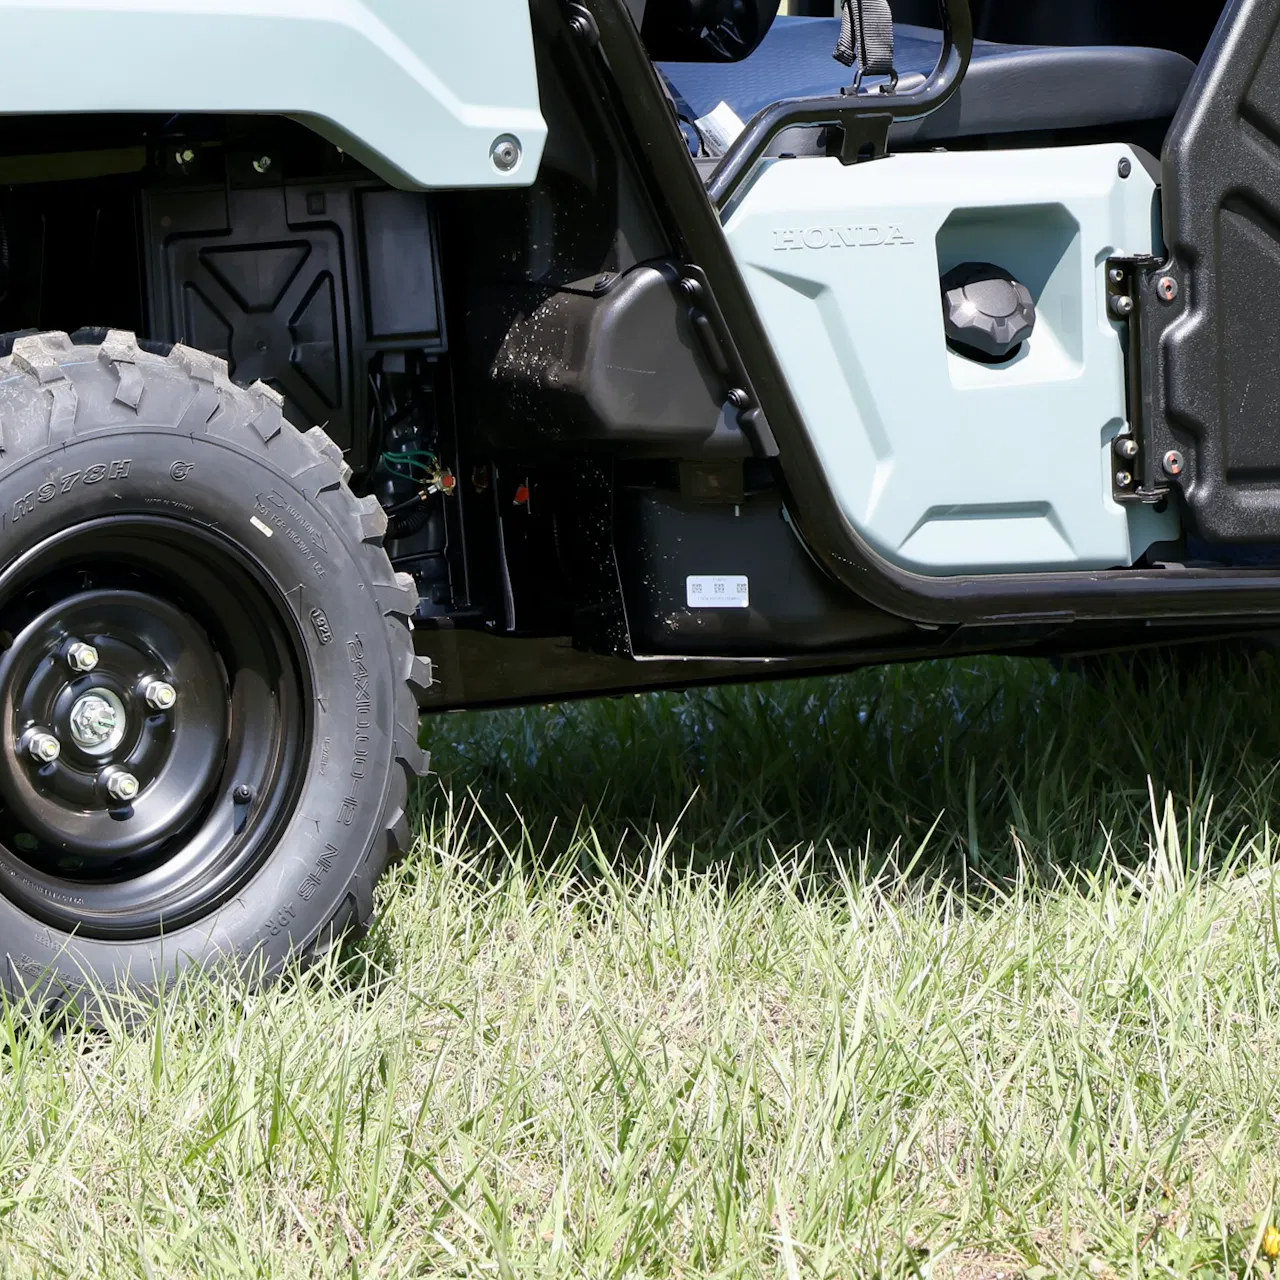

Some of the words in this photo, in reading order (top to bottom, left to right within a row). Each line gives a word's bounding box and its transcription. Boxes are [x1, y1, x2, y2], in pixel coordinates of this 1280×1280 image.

[772, 224, 915, 251] HONDA
[11, 459, 133, 522] M978H
[285, 527, 316, 560] HIGHWAY
